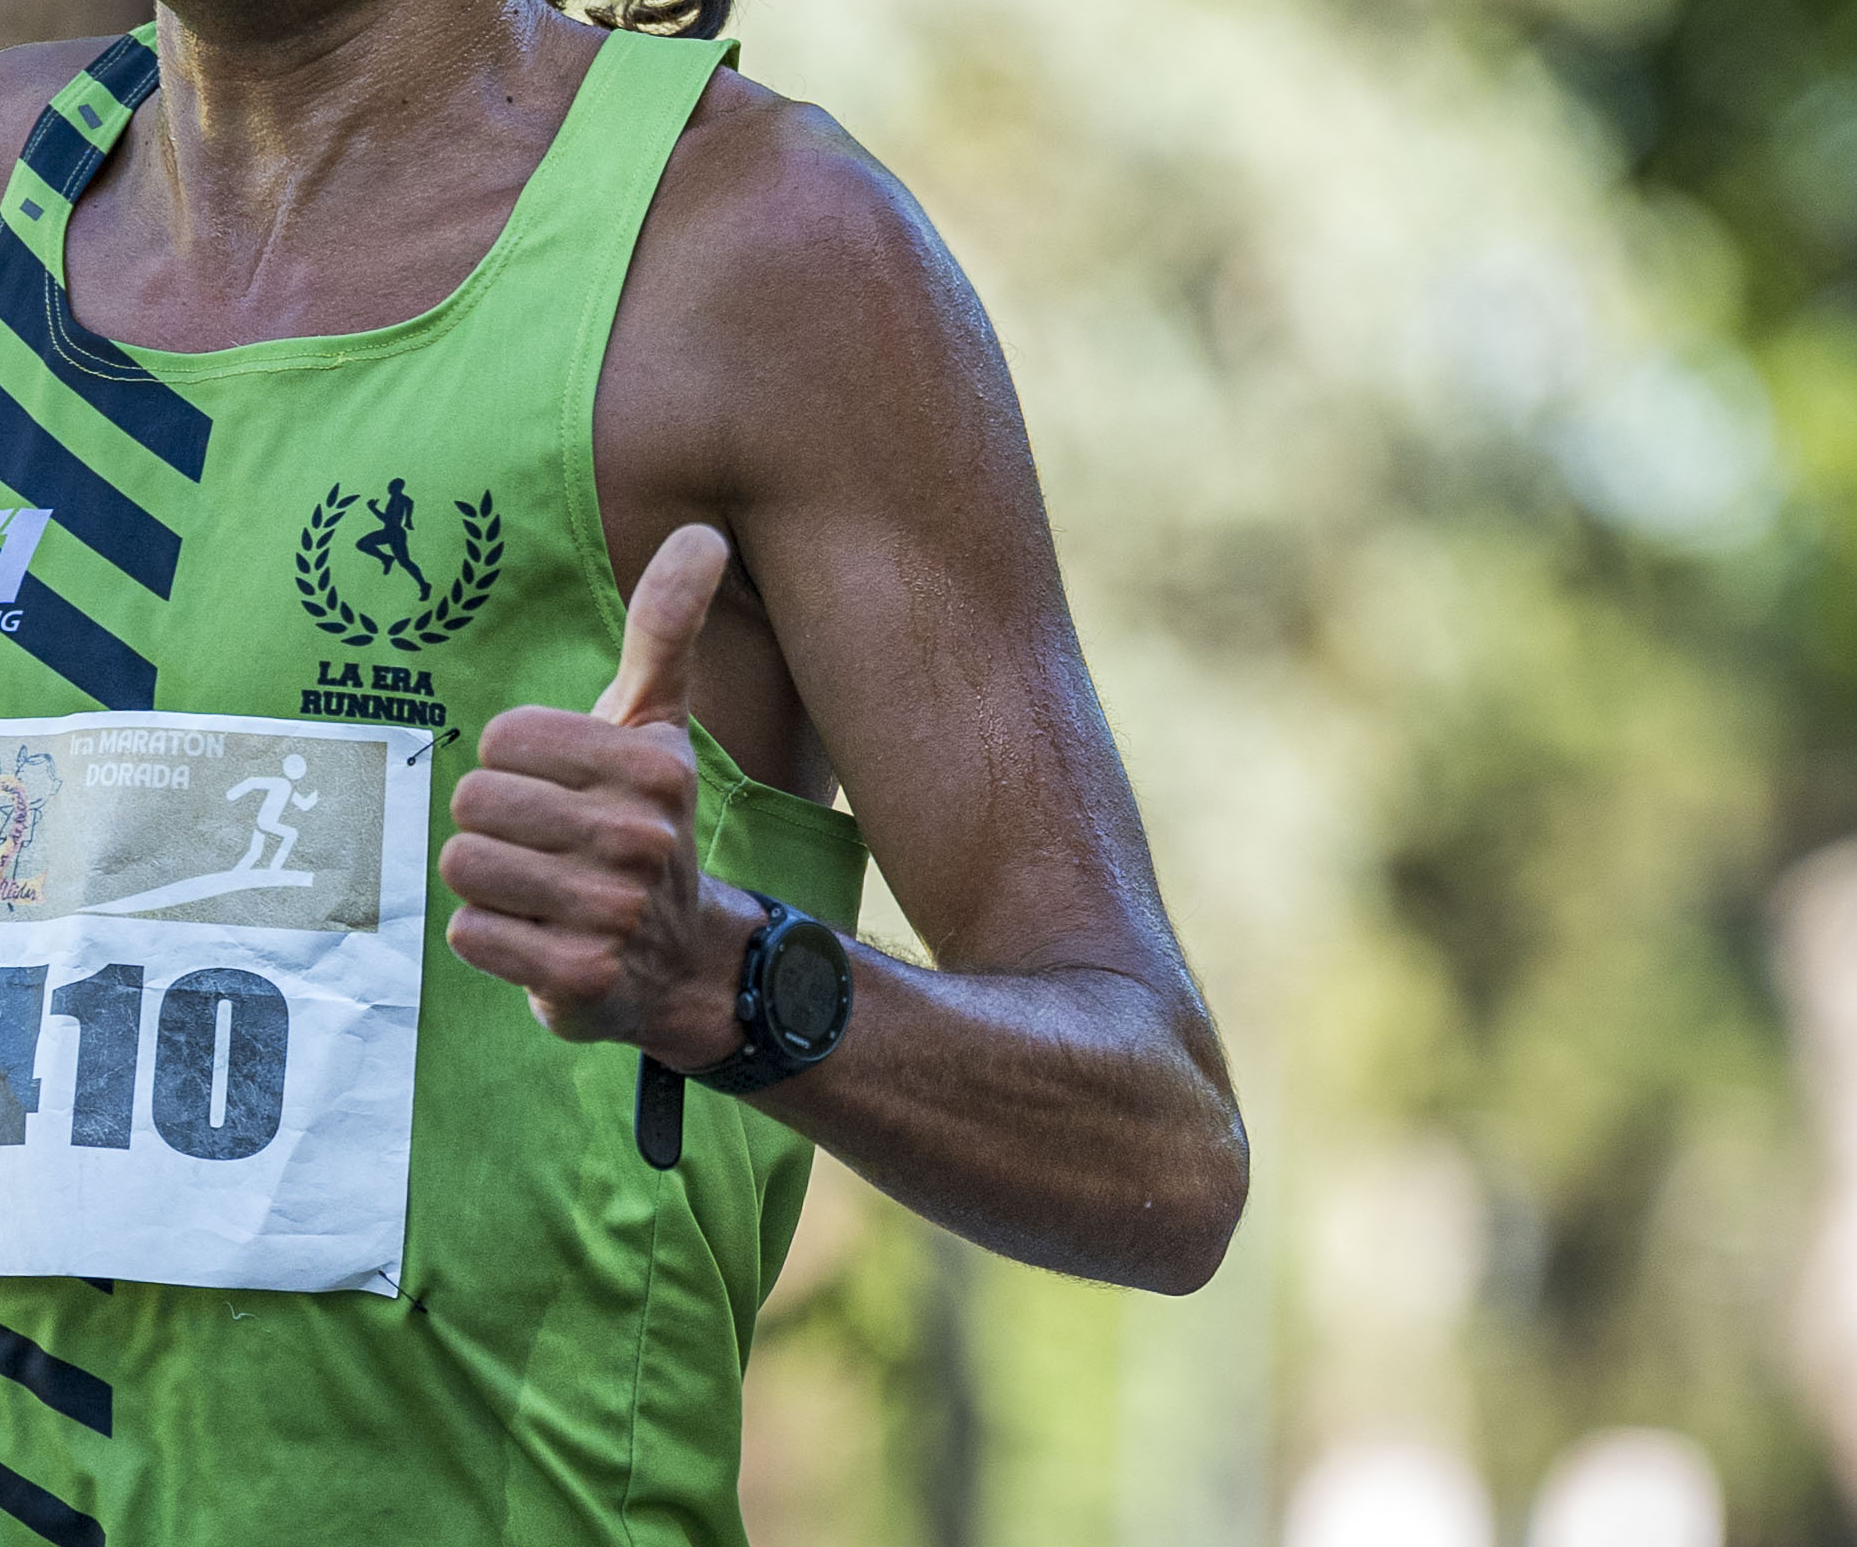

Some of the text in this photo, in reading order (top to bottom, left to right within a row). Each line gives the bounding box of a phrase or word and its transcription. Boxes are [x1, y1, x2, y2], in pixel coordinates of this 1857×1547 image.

[317, 660, 435, 697] LA ERA
[300, 689, 446, 727] RUNNING
[85, 762, 190, 790] DORADA
